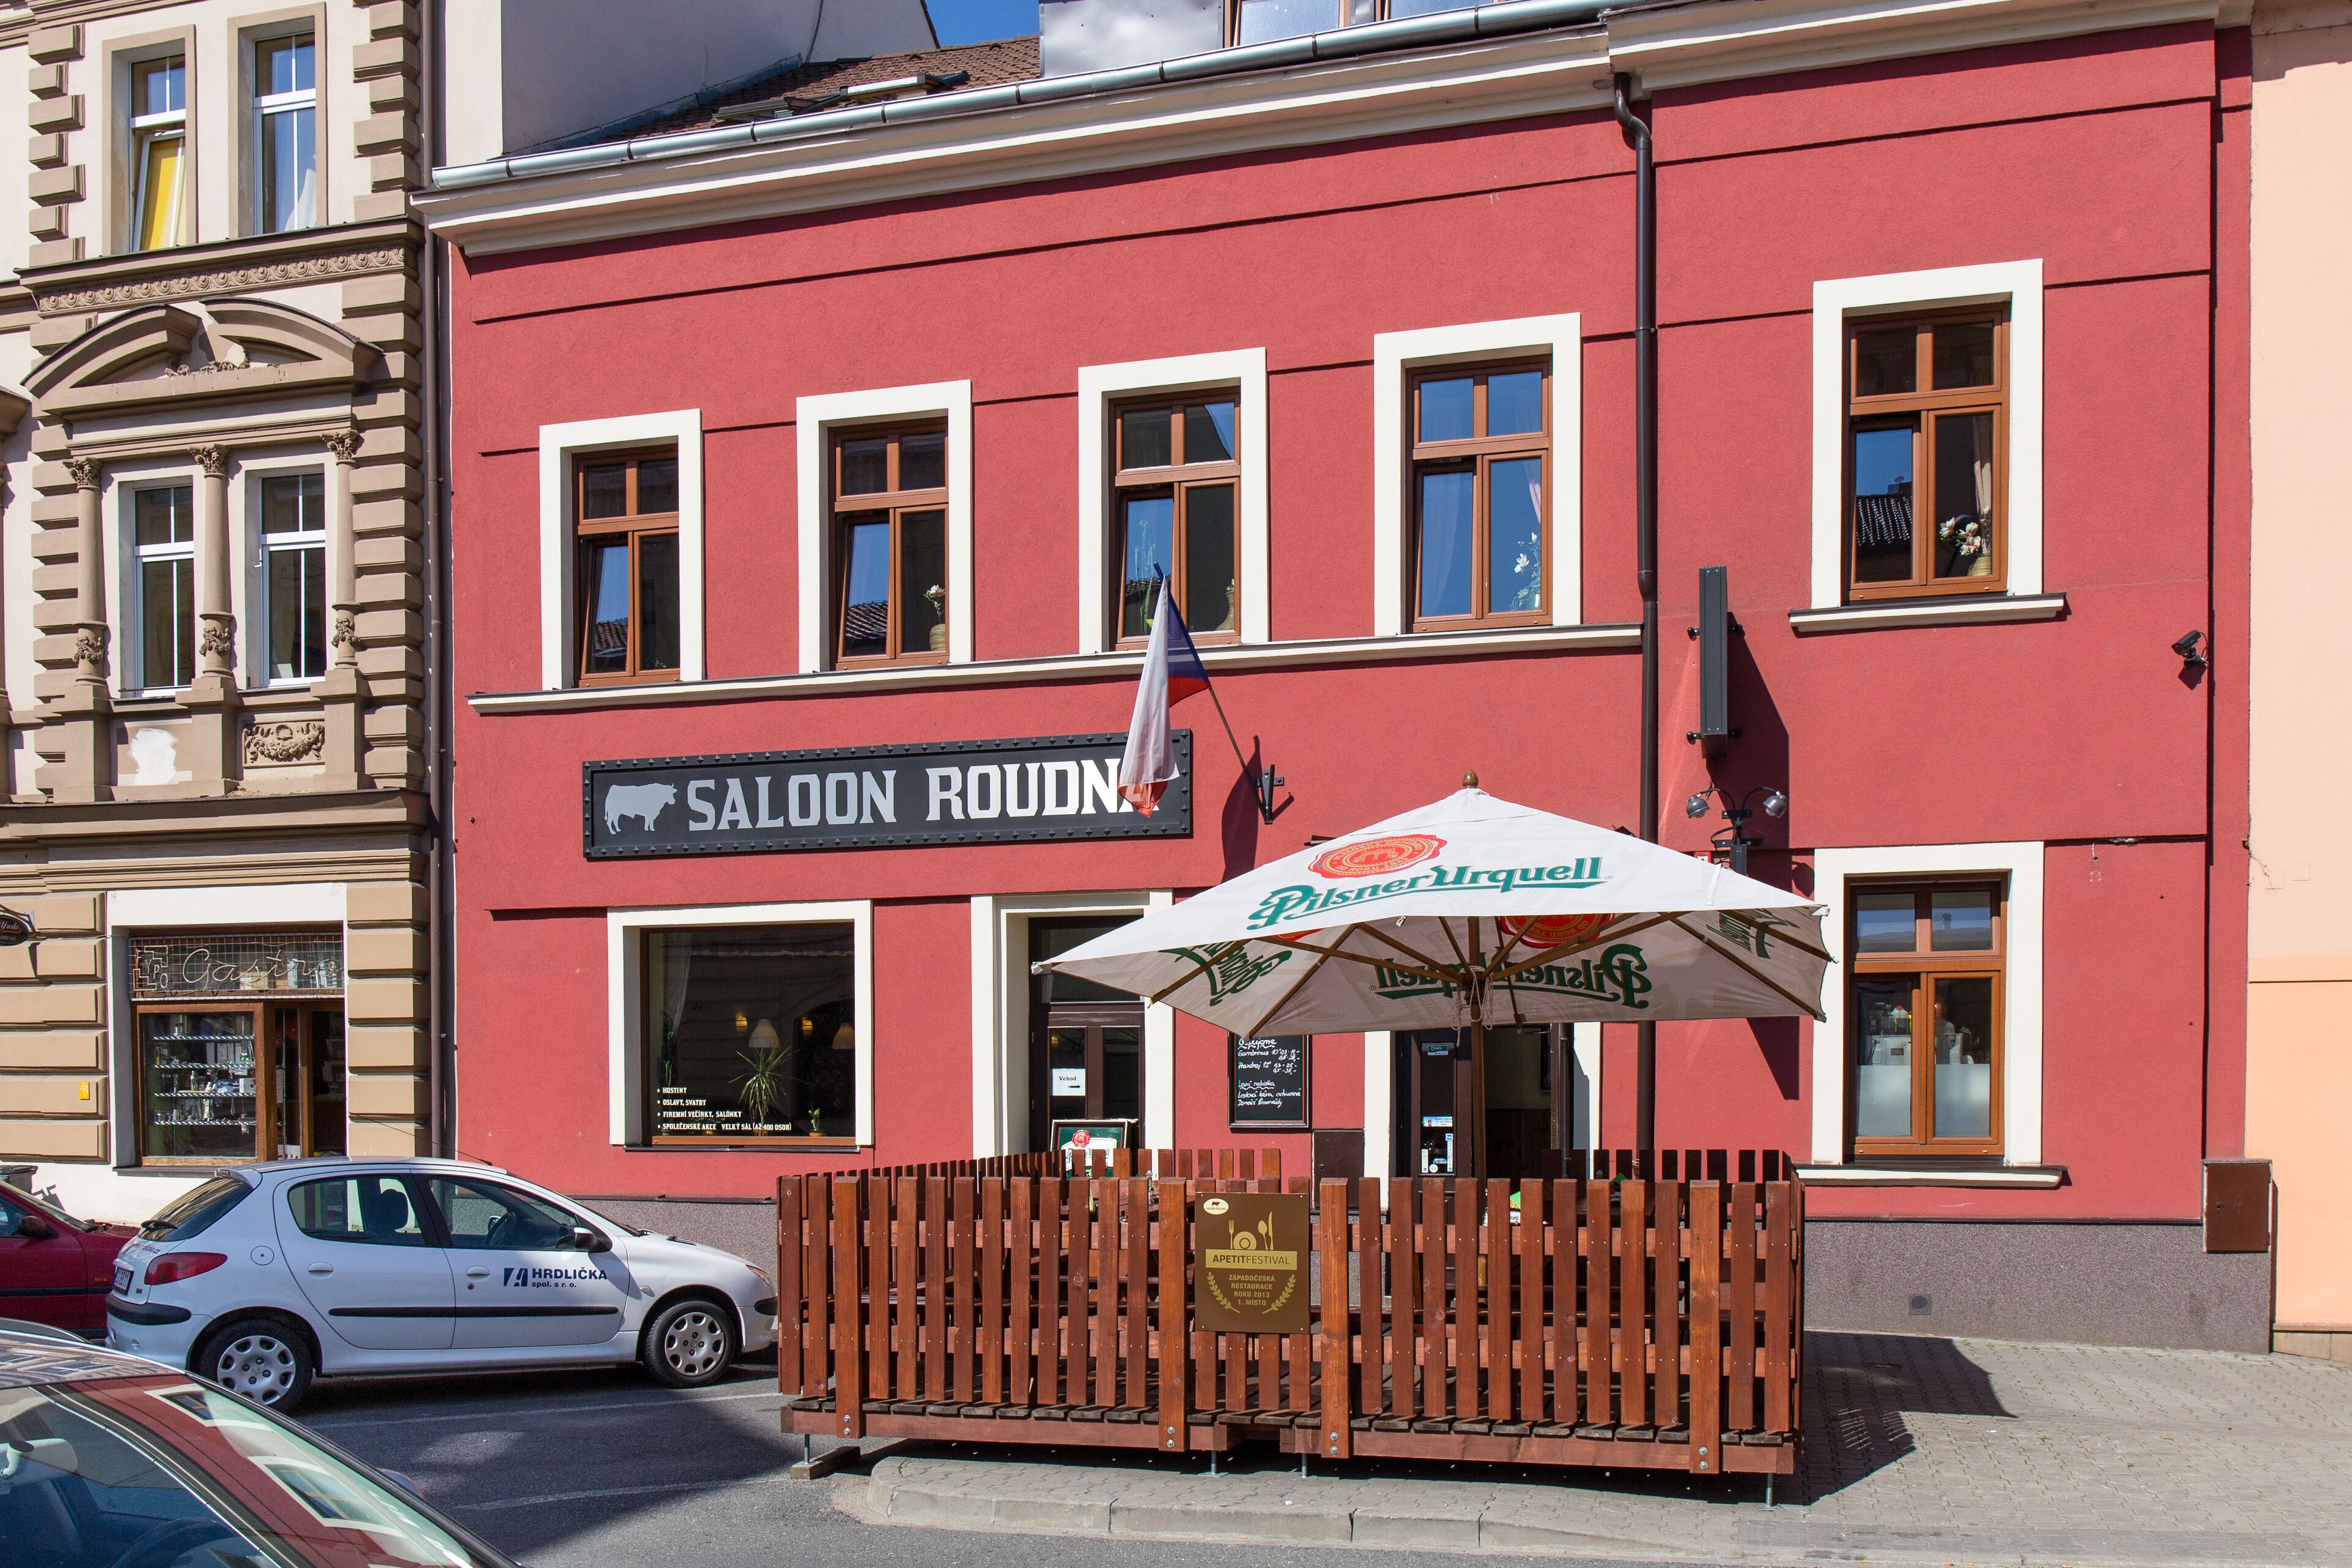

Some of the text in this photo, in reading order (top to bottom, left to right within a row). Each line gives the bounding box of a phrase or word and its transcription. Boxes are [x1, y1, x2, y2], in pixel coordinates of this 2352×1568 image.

[688, 769, 897, 832] SALOON
[1246, 856, 1603, 930] Pilsner Urquell
[183, 949, 342, 990] Gastro
[688, 1110, 714, 1118] VEČÍRKY,
[753, 1122, 762, 1131] (AŽ
[774, 1122, 791, 1131] OSOB)
[1212, 1254, 1290, 1265] APETITFESTIVAL
[532, 1266, 608, 1280] HRDLIČKA
[1229, 1273, 1275, 1282] ZÁPADOČESKÁ
